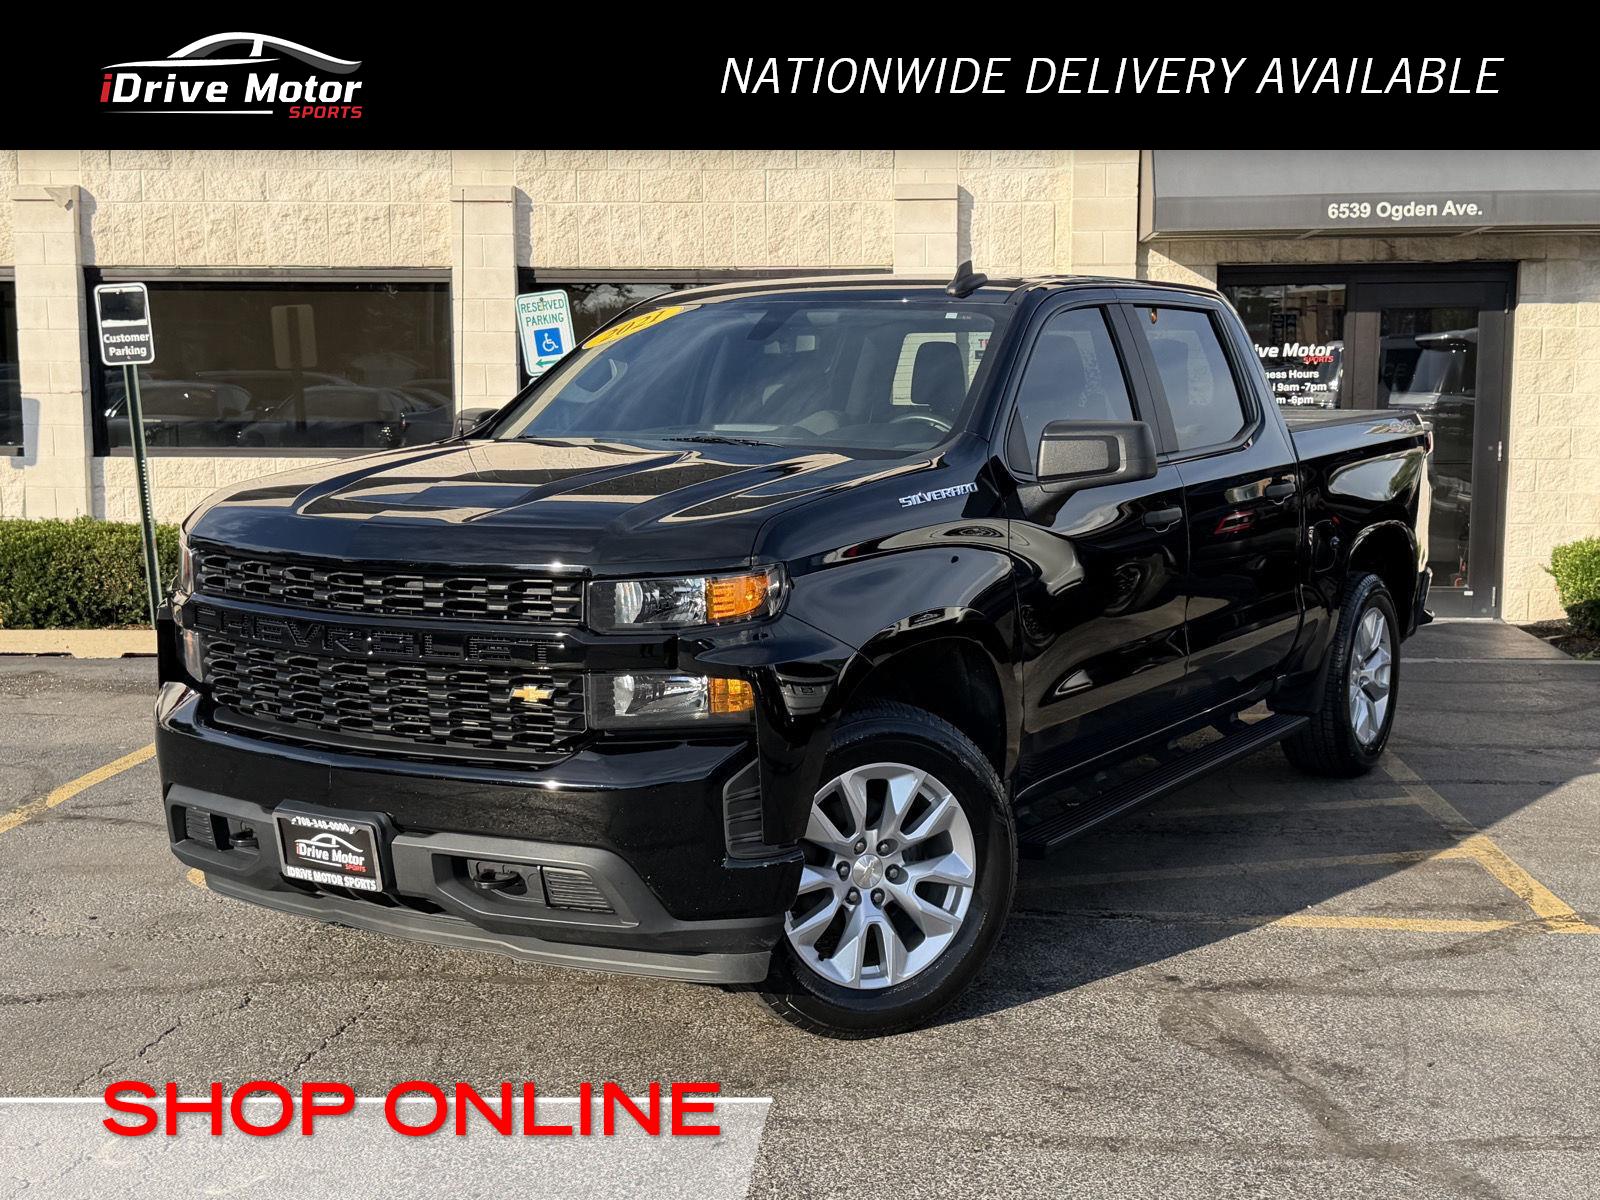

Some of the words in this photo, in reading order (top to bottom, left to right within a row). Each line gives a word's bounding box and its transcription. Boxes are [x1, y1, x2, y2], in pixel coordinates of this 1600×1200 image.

[1327, 202, 1372, 219] 6539
[1376, 201, 1438, 221] Ogden
[1441, 200, 1483, 217] Ave.
[520, 298, 565, 313] RESERVED
[525, 312, 564, 327] PARKING
[103, 333, 150, 344] Customer
[108, 346, 147, 357] Parking
[1282, 342, 1335, 357] Motor
[1288, 369, 1319, 379] Hours
[1277, 382, 1299, 392] 9am
[898, 481, 979, 508] SILVERADO
[193, 605, 565, 664] CHEVROLET
[295, 842, 329, 861] iDrive
[331, 849, 365, 866] Motor
[313, 870, 343, 886] MOTOR
[343, 876, 377, 891] SPORTS
